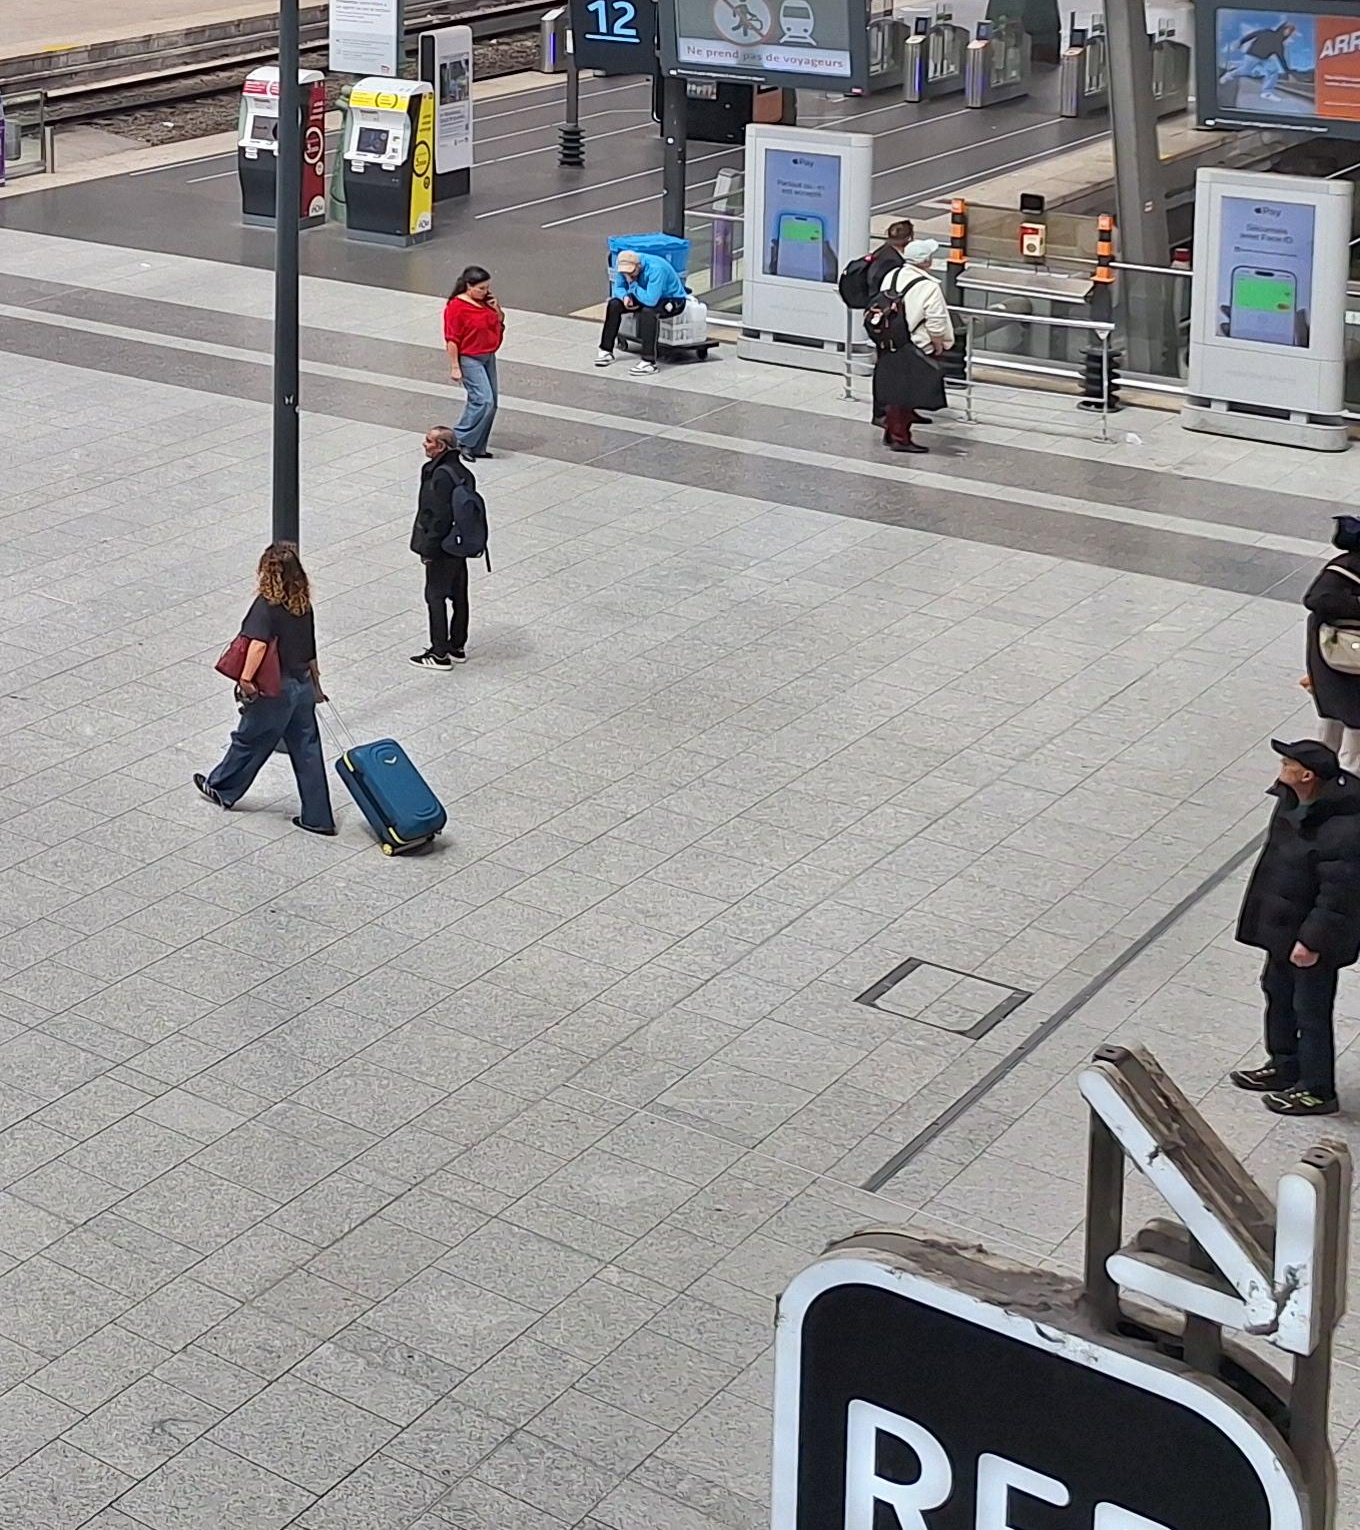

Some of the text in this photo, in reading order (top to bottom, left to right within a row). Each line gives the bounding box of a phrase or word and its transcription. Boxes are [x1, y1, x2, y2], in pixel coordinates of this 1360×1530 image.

[585, 0, 638, 37] 12
[686, 45, 844, 69] Ne prend pas de voyageurs
